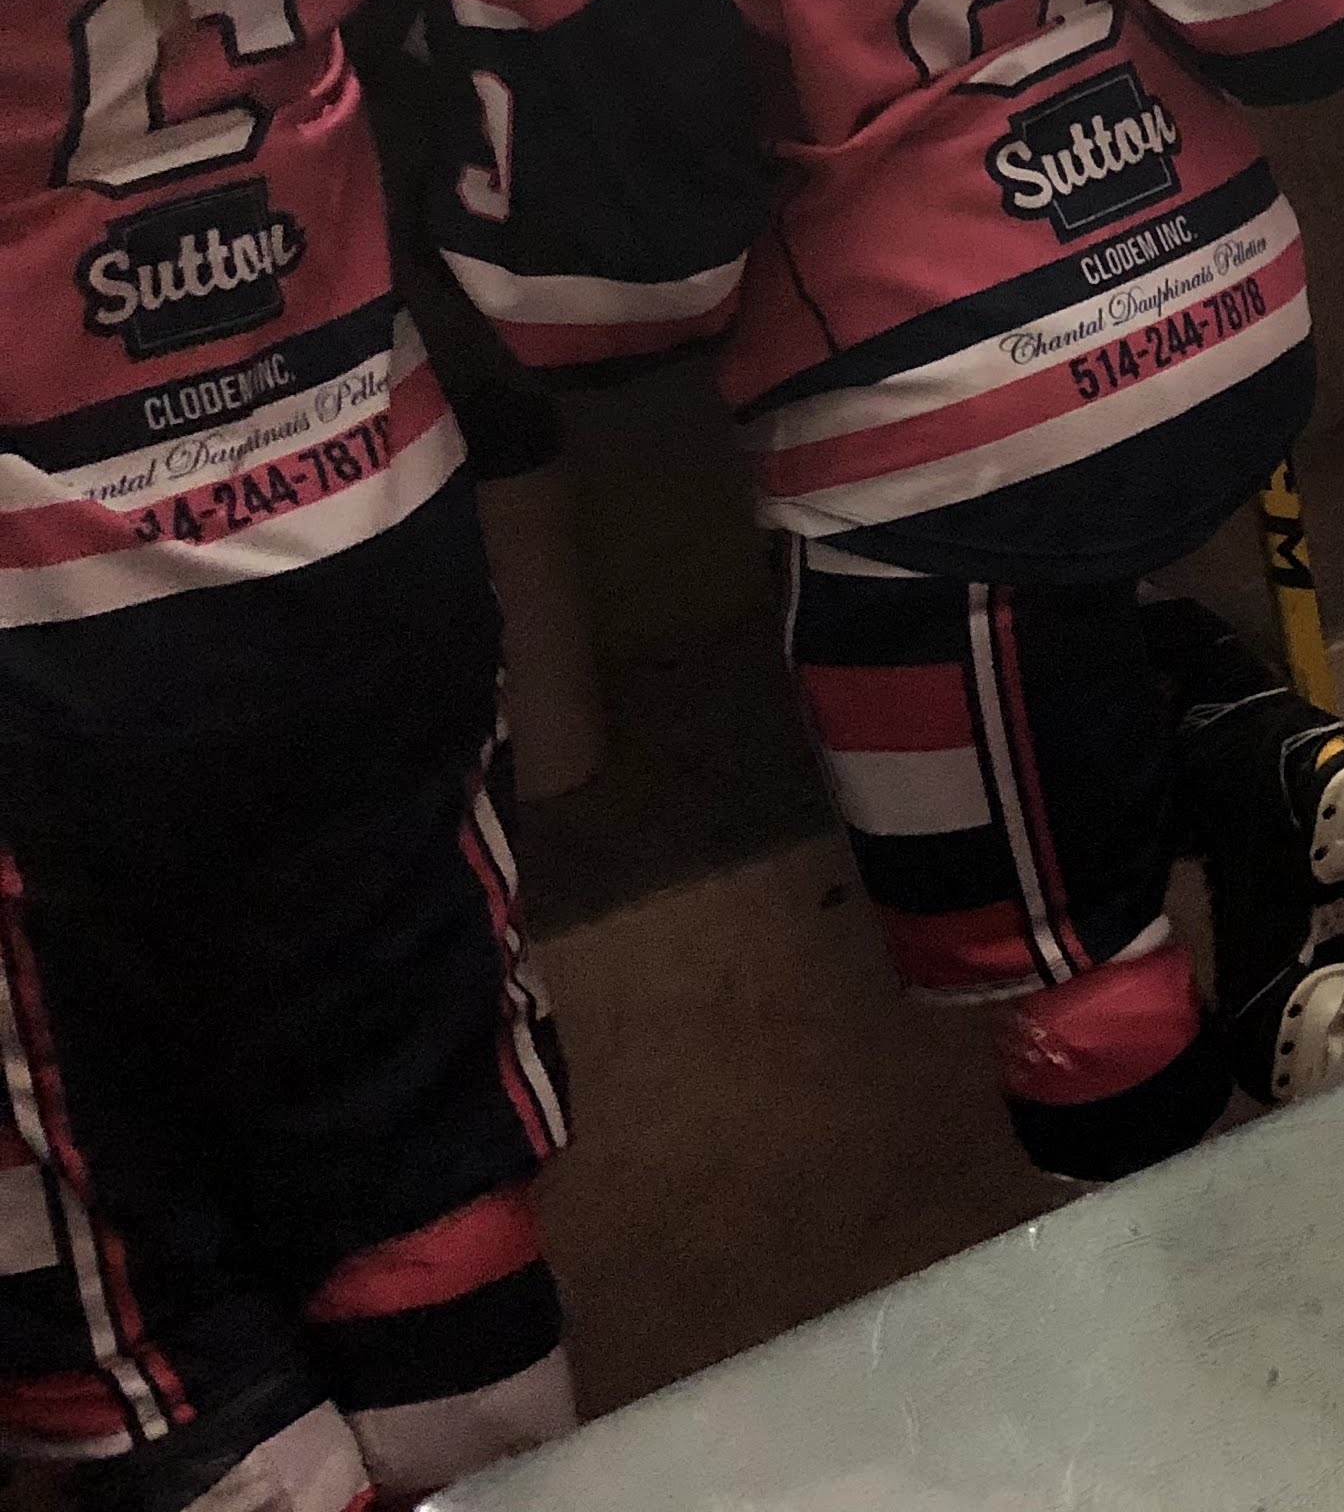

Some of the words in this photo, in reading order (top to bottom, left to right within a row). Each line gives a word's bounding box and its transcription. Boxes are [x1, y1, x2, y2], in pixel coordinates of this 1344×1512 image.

[995, 104, 1178, 210] Sutton
[87, 221, 301, 326] Sutton
[1081, 228, 1159, 287] CLODEM
[1160, 216, 1200, 255] INC.
[1069, 276, 1268, 401] 514-244-7878
